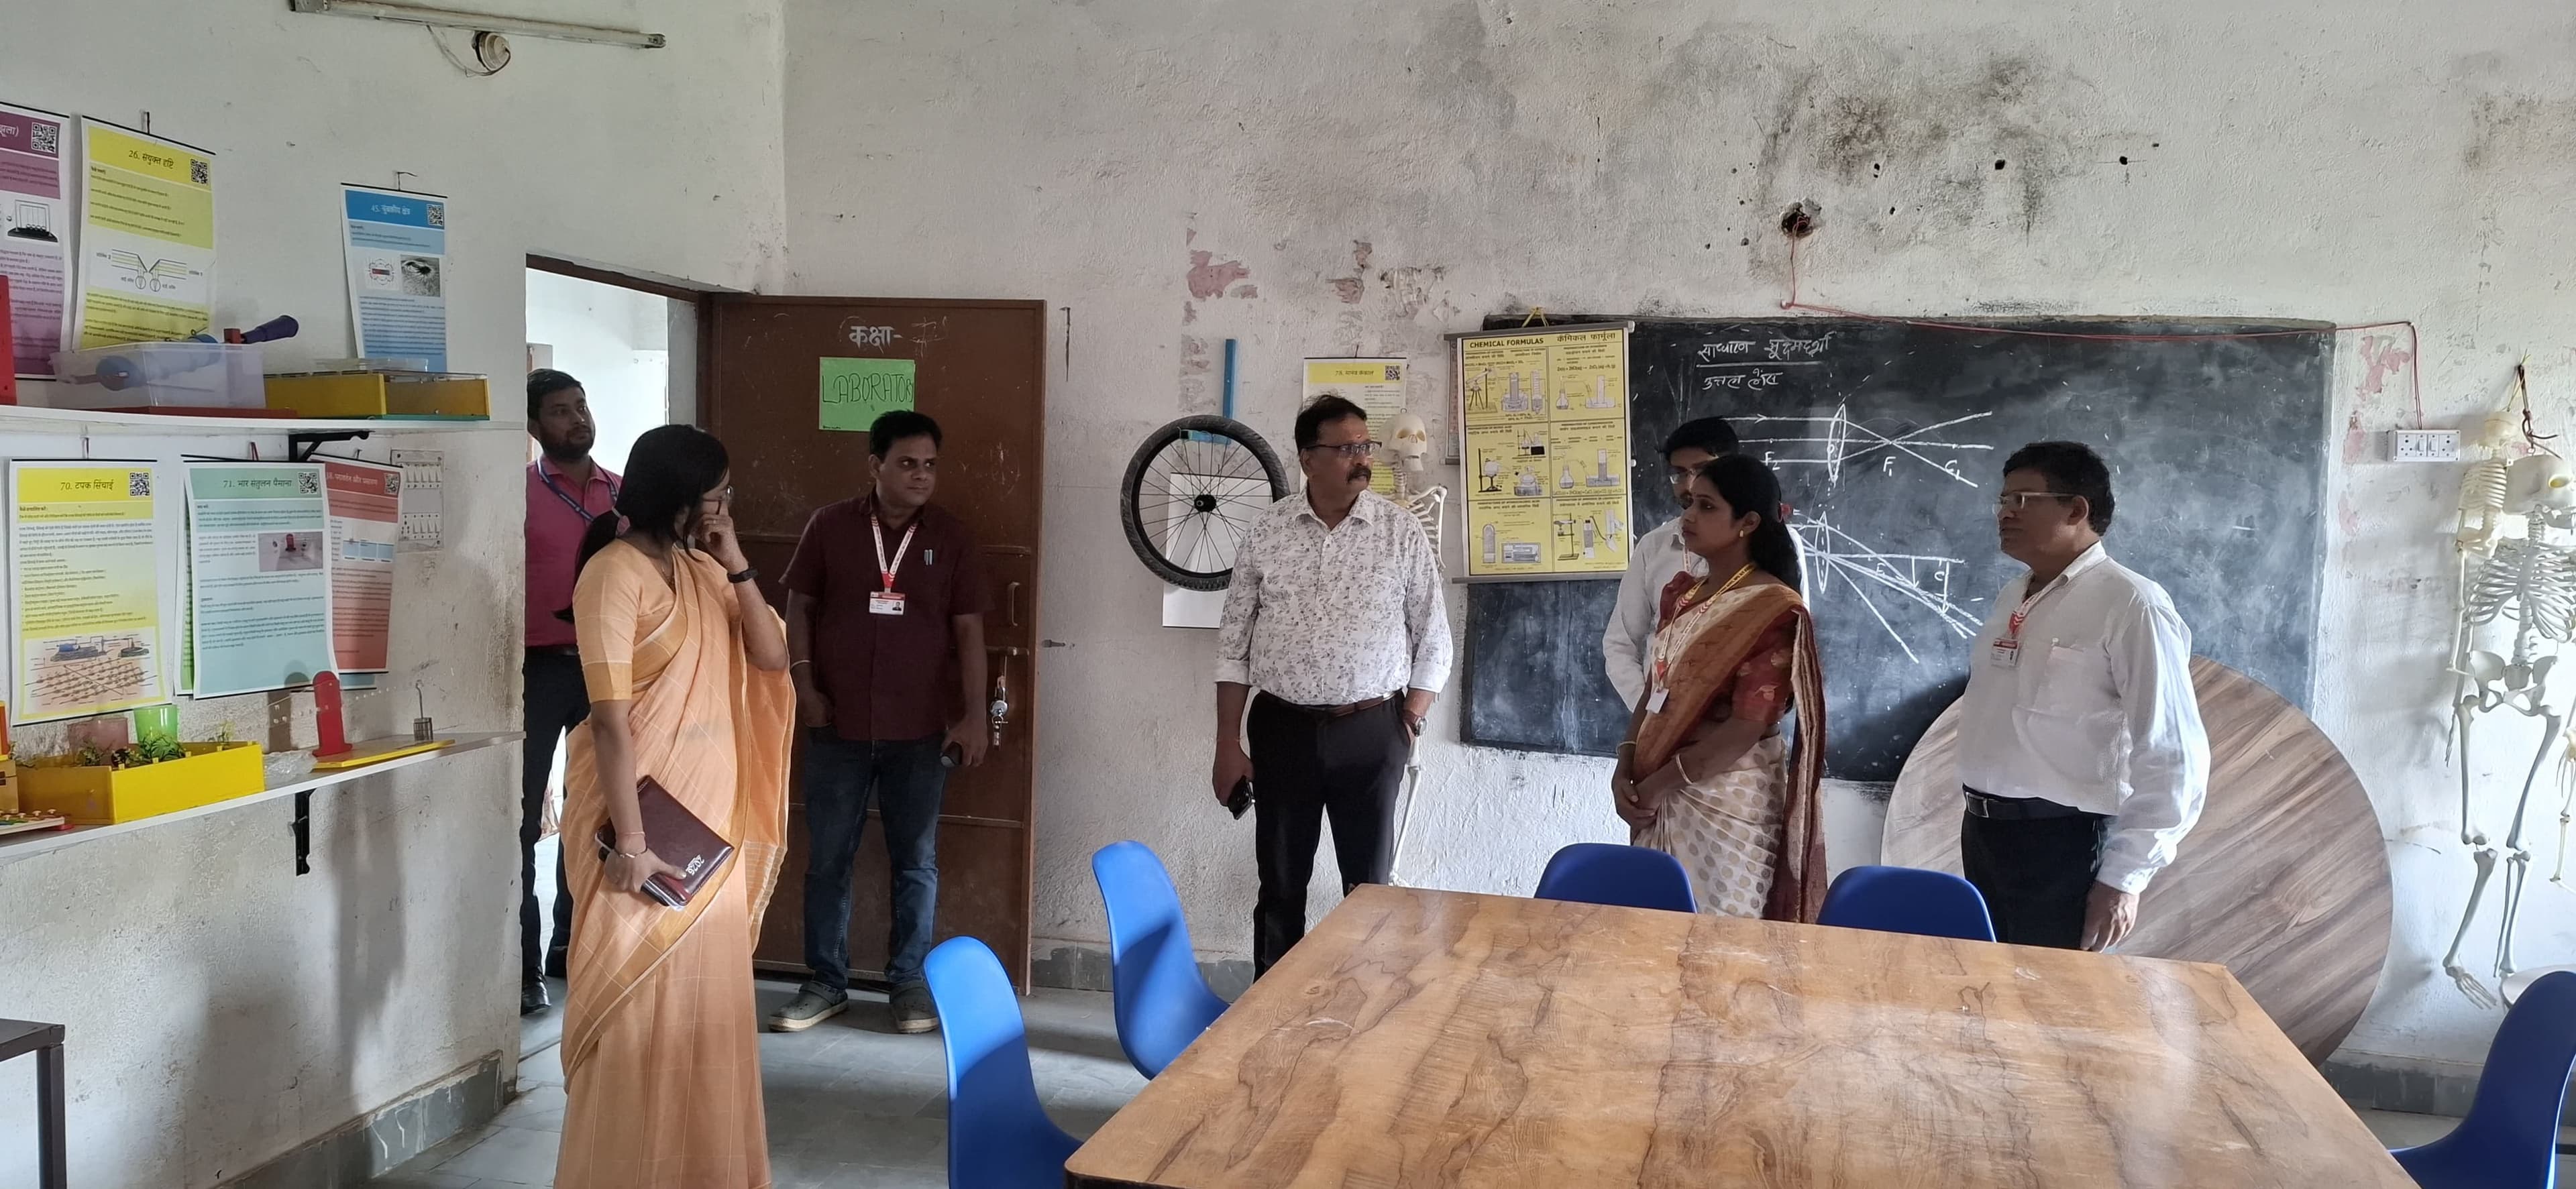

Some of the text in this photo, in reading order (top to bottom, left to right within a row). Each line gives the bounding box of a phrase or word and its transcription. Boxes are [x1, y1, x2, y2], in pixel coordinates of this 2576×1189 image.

[128, 150, 140, 160] 26.
[1469, 337, 1544, 349] CHEMICAL FORMULAS
[60, 482, 72, 491] 70.
[93, 479, 114, 491] सिंचाई
[223, 479, 235, 488] 71.
